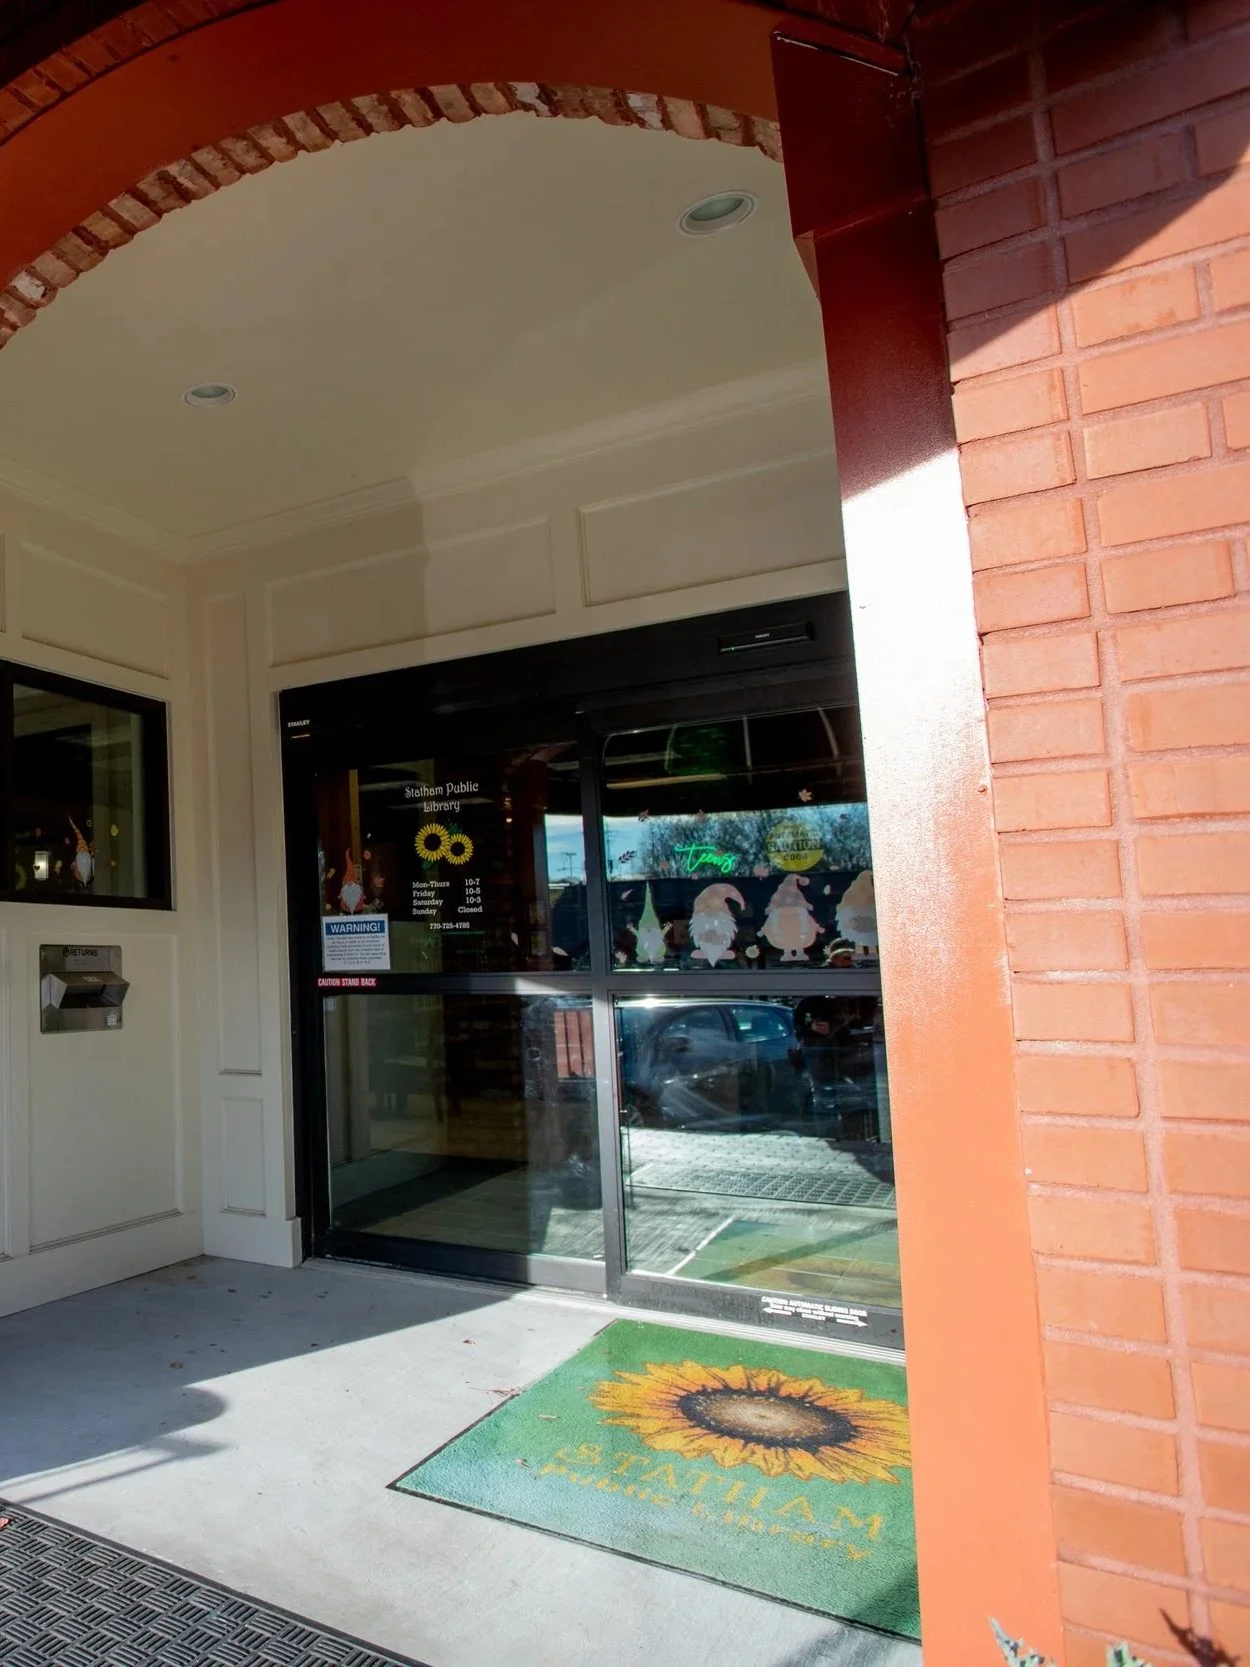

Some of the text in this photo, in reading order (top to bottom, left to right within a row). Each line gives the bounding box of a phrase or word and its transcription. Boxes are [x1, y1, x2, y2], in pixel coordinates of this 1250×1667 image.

[404, 780, 479, 799] Statham Public
[423, 800, 461, 813] Library
[674, 842, 737, 874] teens
[412, 878, 481, 889] Mon-Thurs 10-7
[412, 887, 481, 898] Friday 10-5
[412, 896, 482, 906] Saturday 10-3
[412, 905, 483, 916] Sunday Closed
[330, 922, 381, 933] WARNING!
[69, 948, 98, 957] RETURNS
[317, 977, 377, 987] CAUTION STAND BACK
[555, 1441, 884, 1541] STATHAM
